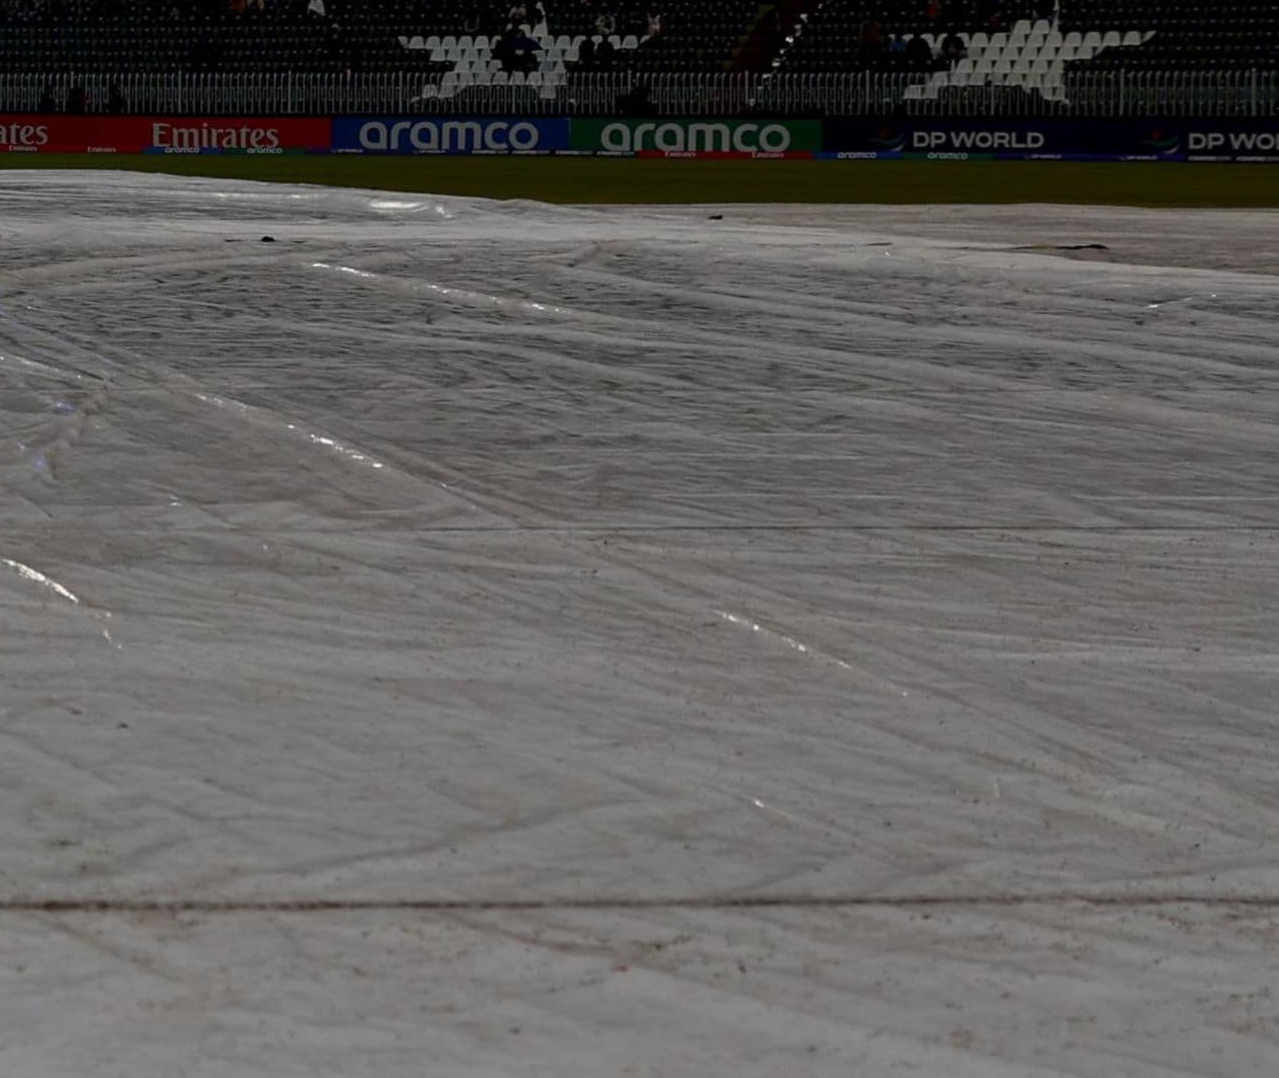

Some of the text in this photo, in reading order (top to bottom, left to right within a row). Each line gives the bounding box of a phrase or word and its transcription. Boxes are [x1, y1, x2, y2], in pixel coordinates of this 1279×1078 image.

[152, 122, 280, 148] Emirates
[359, 121, 539, 150] aramco
[601, 122, 791, 152] aramco
[914, 132, 1045, 149] DP WORLD
[1188, 132, 1279, 150] DP WO
